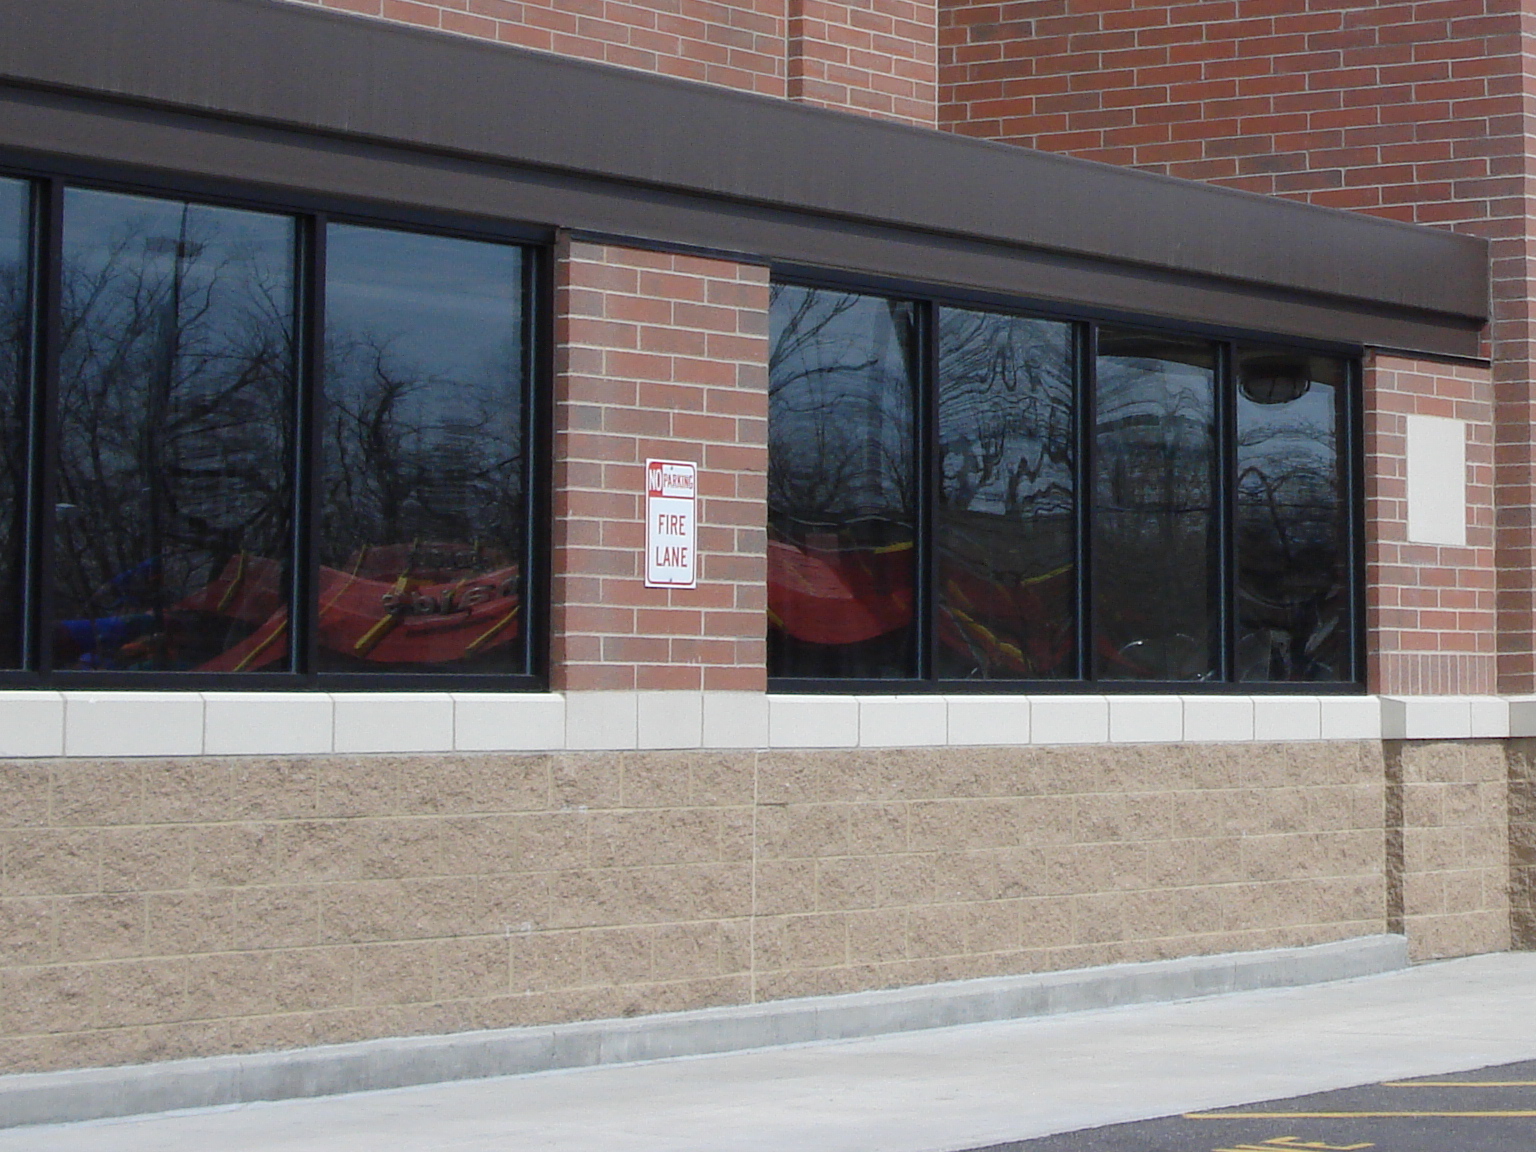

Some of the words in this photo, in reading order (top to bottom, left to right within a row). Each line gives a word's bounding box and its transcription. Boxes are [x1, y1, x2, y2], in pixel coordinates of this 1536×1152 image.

[649, 468, 662, 491] NO
[663, 473, 694, 490] PARKING
[658, 514, 687, 536] FIRE
[655, 546, 688, 568] LANE
